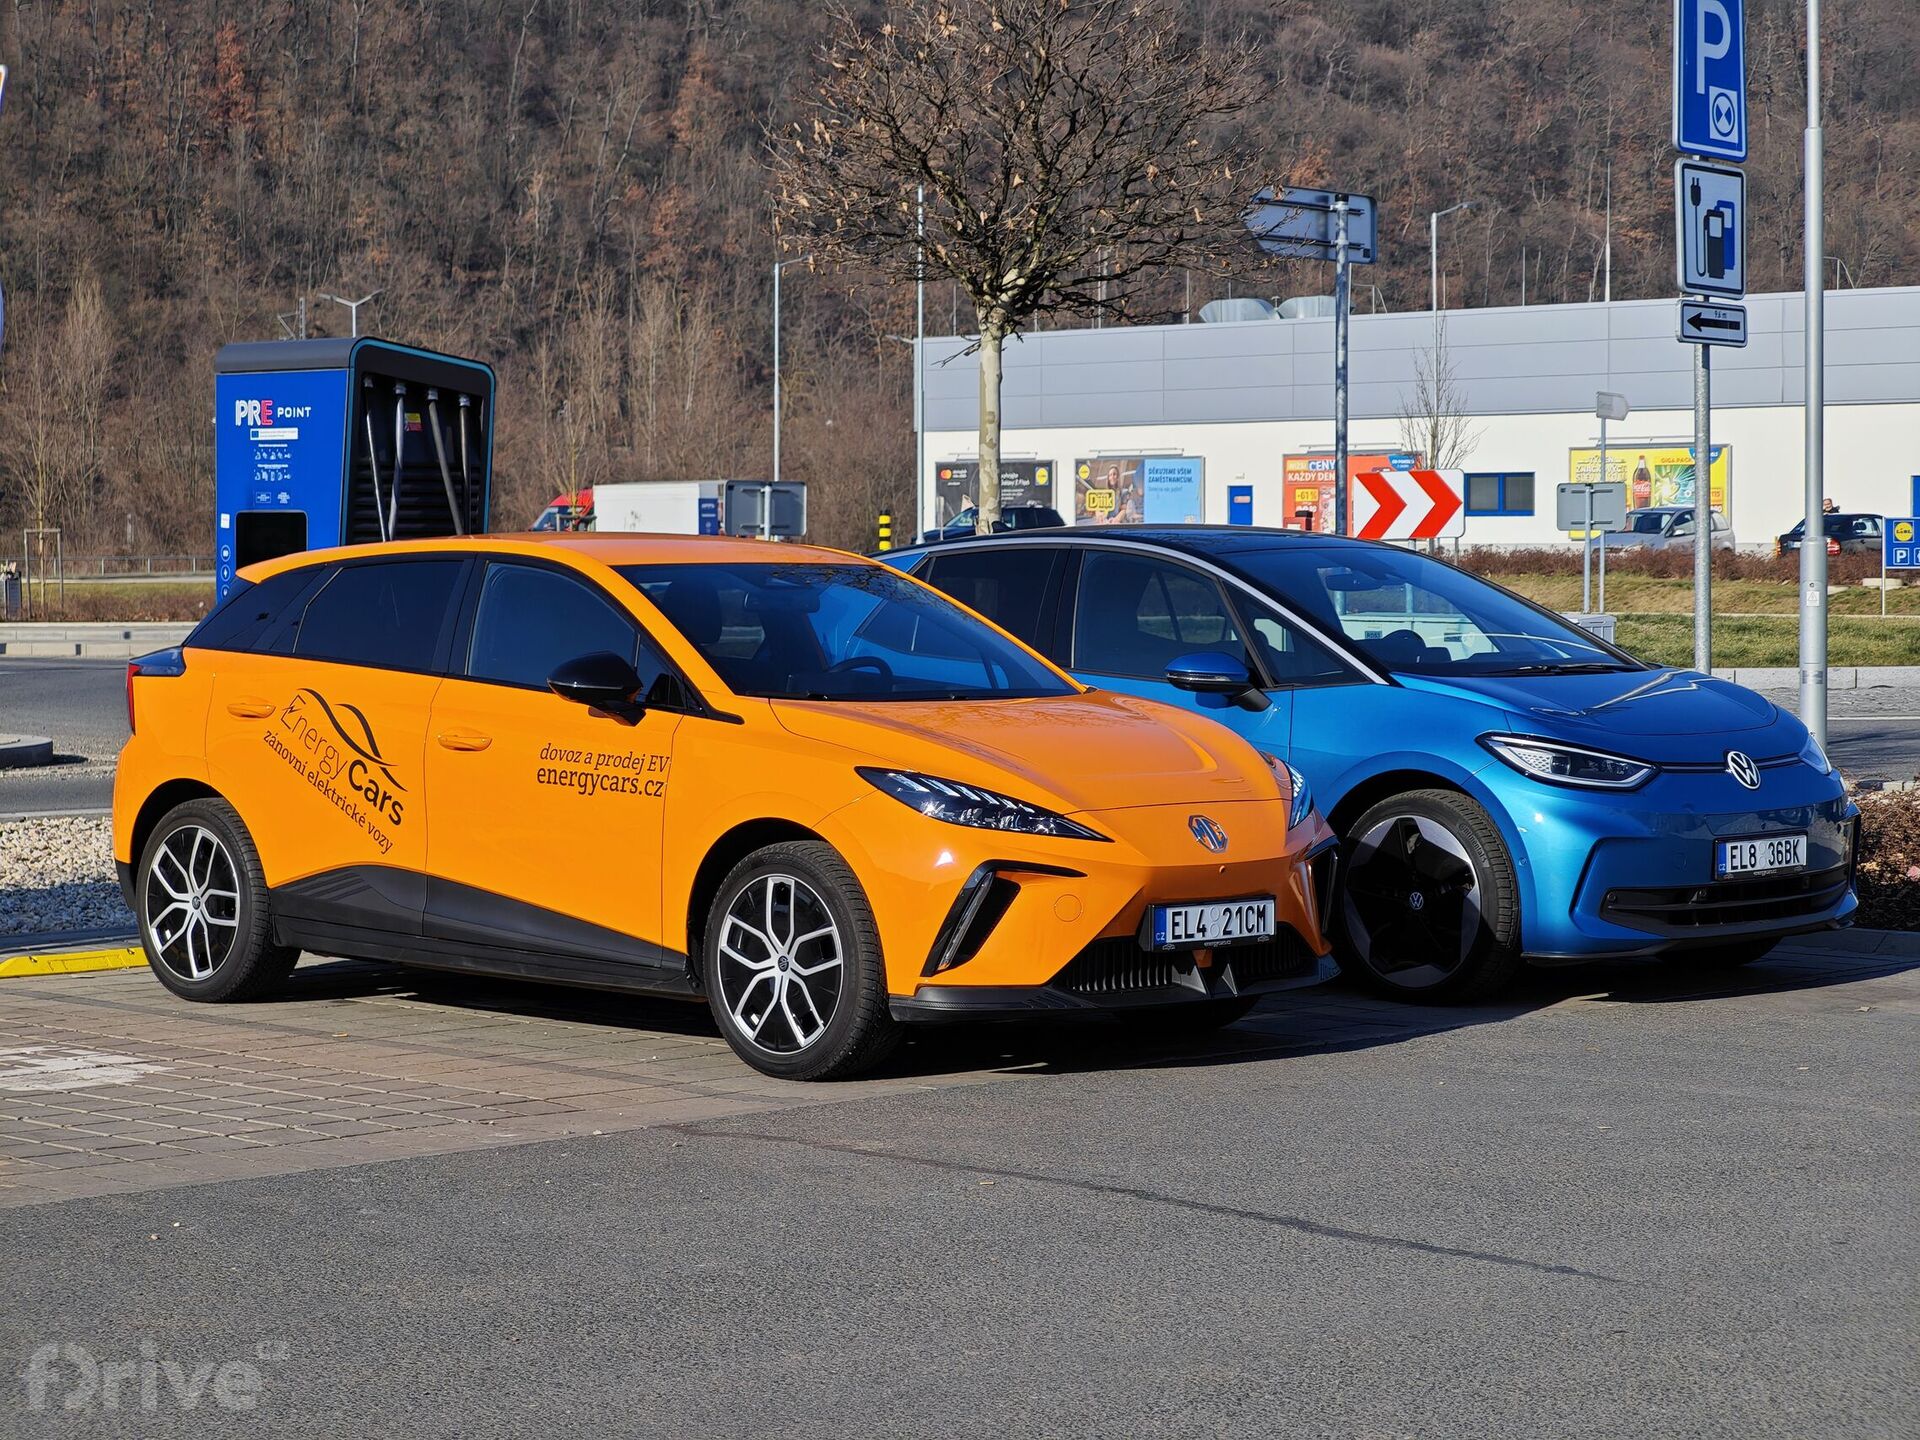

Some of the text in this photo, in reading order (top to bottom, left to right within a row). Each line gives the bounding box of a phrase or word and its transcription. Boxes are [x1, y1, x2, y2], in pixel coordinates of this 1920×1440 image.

[1696, 0, 1732, 95] P
[235, 399, 312, 426] PRE POINT
[1288, 471, 1317, 481] KAŽDÝ
[1896, 550, 1907, 563] P
[263, 729, 309, 776] zánovní
[539, 742, 670, 776] dovoz a prodej EV
[307, 770, 367, 828] elektrické
[536, 766, 665, 798] energycars.cz
[367, 821, 394, 855] vozy
[1730, 844, 1757, 870] EL8
[1767, 839, 1800, 866] 36BK
[1155, 904, 1266, 941] CZ EL4 21CM
